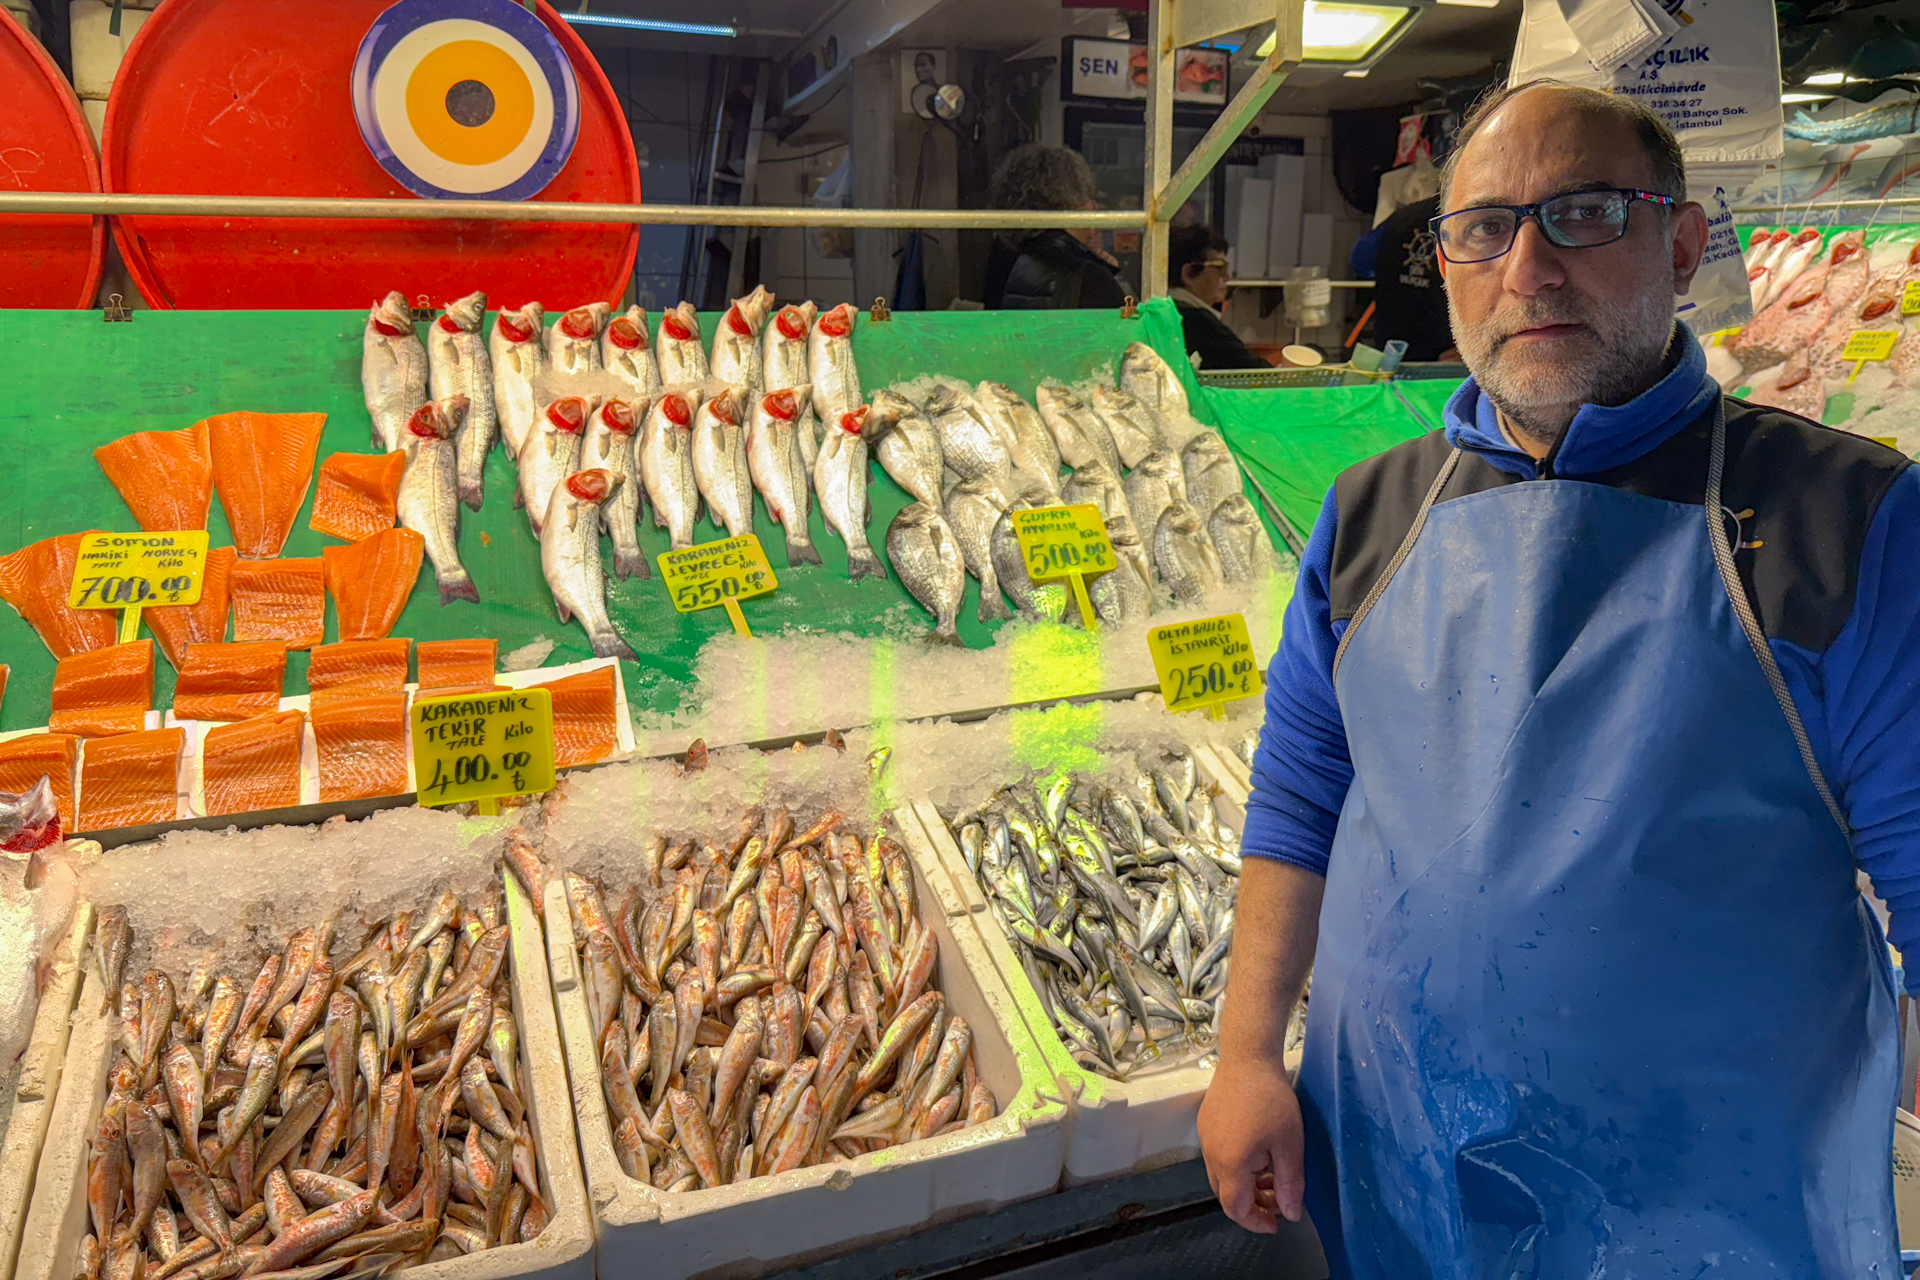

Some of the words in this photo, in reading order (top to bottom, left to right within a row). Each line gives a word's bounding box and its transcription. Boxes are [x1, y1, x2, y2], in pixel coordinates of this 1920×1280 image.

[1646, 46, 1710, 69] ÇILIK
[1079, 56, 1118, 77] ŞEN
[1672, 99, 1687, 108] 34
[1689, 98, 1703, 107] 27
[1683, 107, 1719, 120] Bahçe
[1722, 106, 1749, 116] Sok.
[1710, 227, 1734, 241] 0216
[1079, 529, 1101, 539] Kilo
[92, 537, 175, 547] SOMON
[91, 561, 123, 569] TAZE
[157, 560, 183, 569] Kilo
[684, 571, 710, 582] TAZE
[739, 559, 757, 570] Kilo
[1158, 626, 1190, 640] OLTA
[1223, 641, 1249, 656] Kilo
[424, 718, 487, 742] TEKİR
[446, 735, 487, 750] TAZE
[504, 721, 534, 740] Kilo
